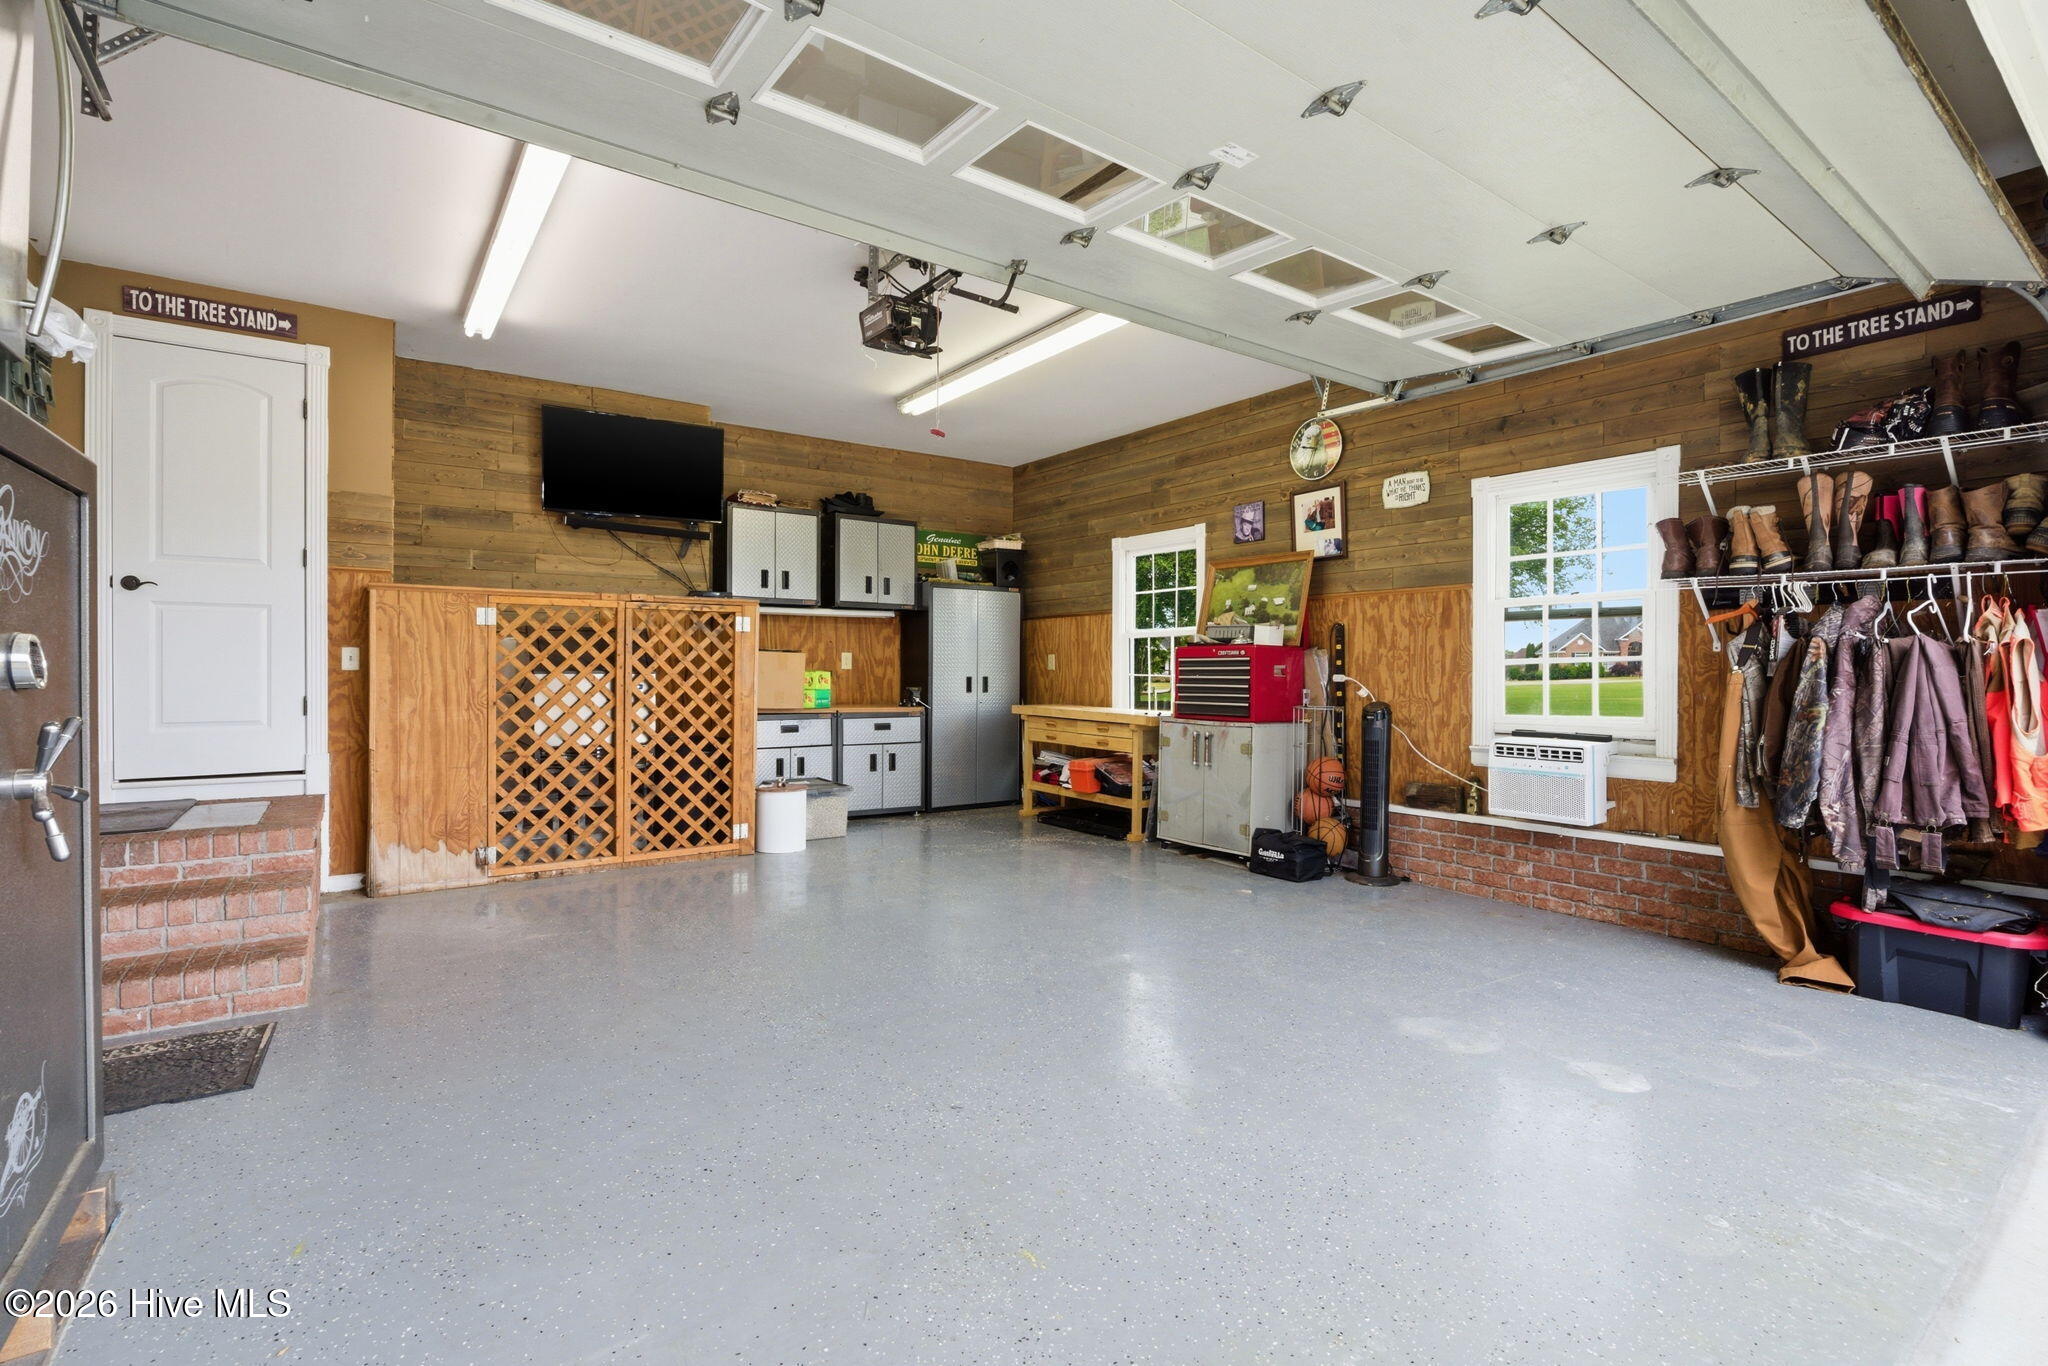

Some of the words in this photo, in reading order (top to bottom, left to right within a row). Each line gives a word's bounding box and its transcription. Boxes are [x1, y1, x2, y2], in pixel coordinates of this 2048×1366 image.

[129, 289, 152, 312] TO
[155, 293, 185, 317] THE
[189, 299, 226, 324] TREE
[229, 306, 277, 331] STAND
[1787, 334, 1810, 353] TO
[1812, 325, 1844, 348] THE
[1847, 314, 1890, 340] TREE
[1894, 300, 1954, 330] STAND
[1398, 491, 1416, 502] RIGHT
[926, 533, 962, 544] Genuine
[917, 543, 939, 556] OHN
[942, 545, 978, 560] DEERE
